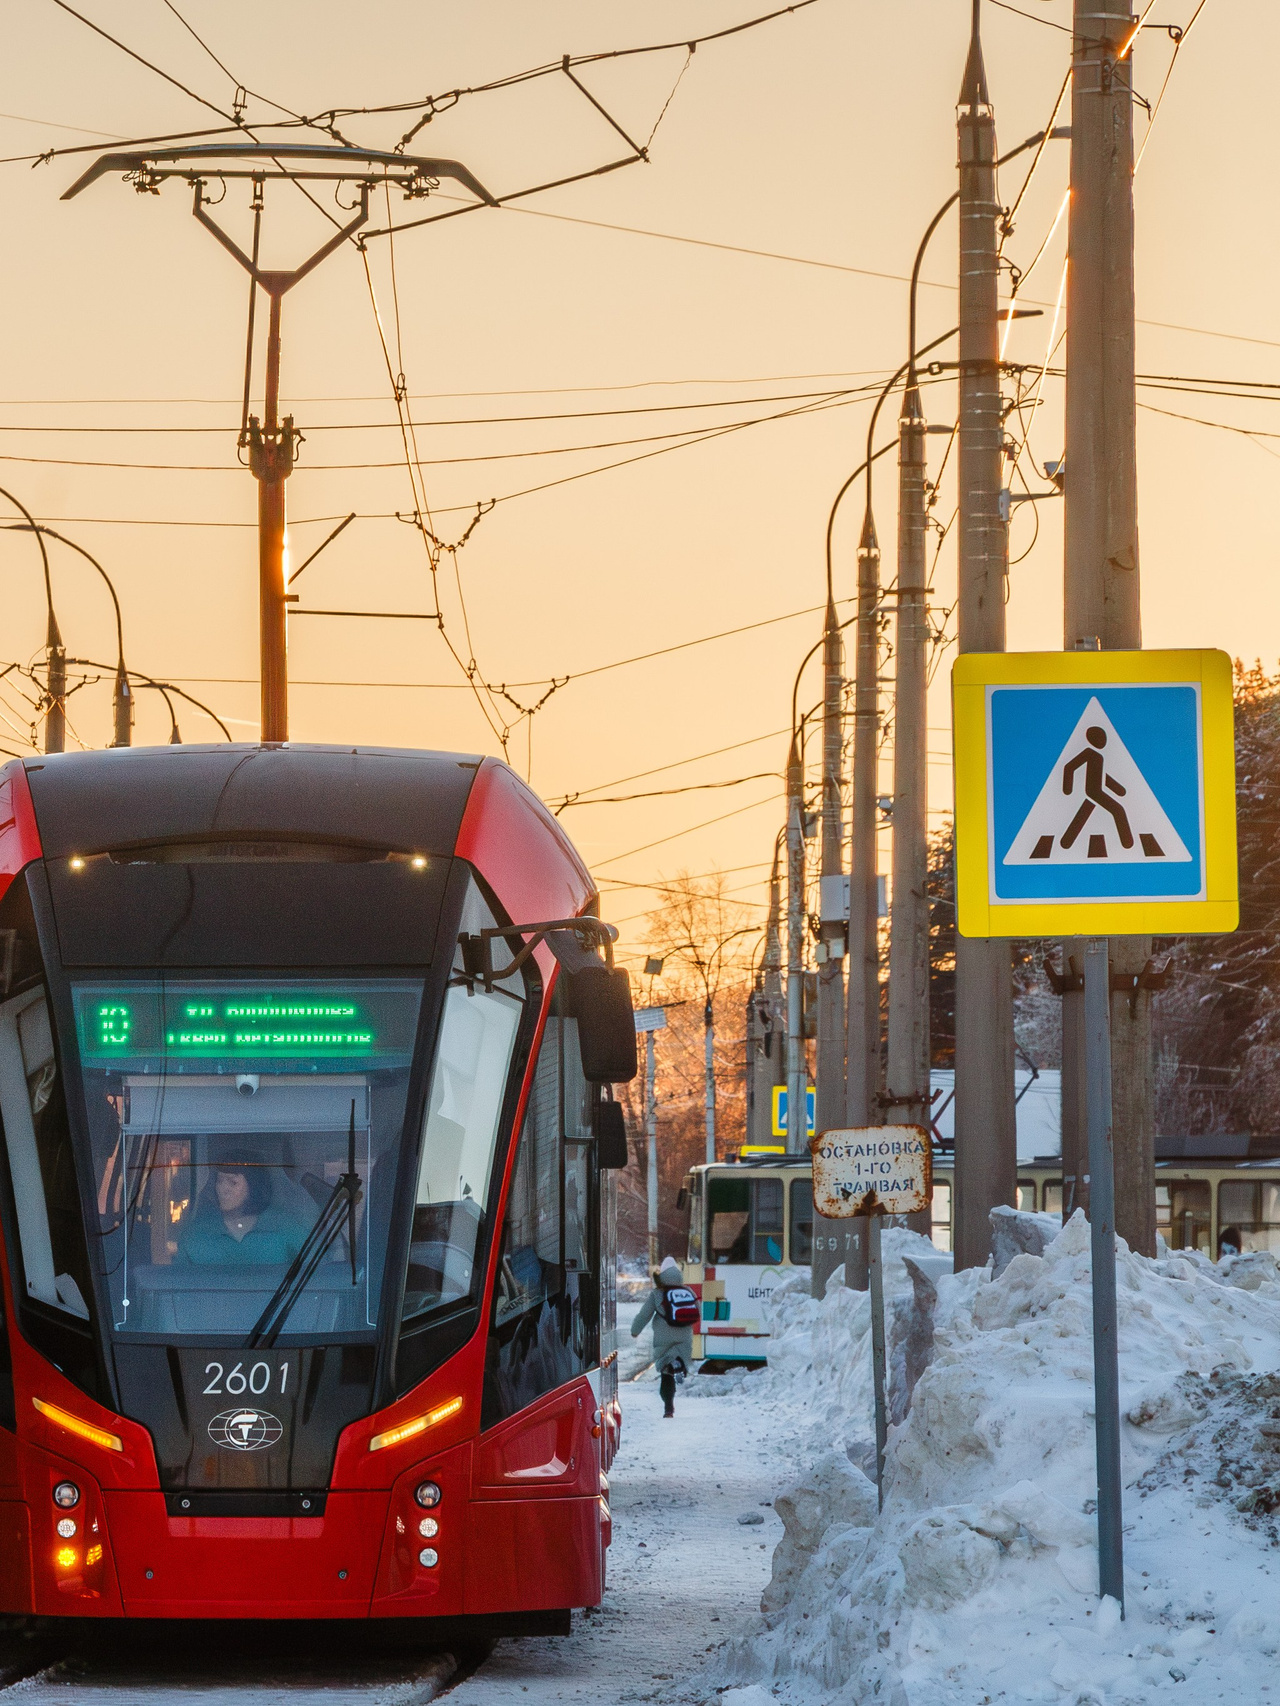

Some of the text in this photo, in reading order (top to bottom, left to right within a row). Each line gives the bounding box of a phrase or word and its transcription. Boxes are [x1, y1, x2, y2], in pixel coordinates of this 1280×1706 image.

[820, 1140, 926, 1159] ОСТАНОВКА
[854, 1161, 891, 1175] 1-ГО
[832, 1179, 914, 1196] ТРАМВАЯ
[748, 1286, 774, 1299] ЦЕНТ
[202, 1361, 289, 1395] 2601
